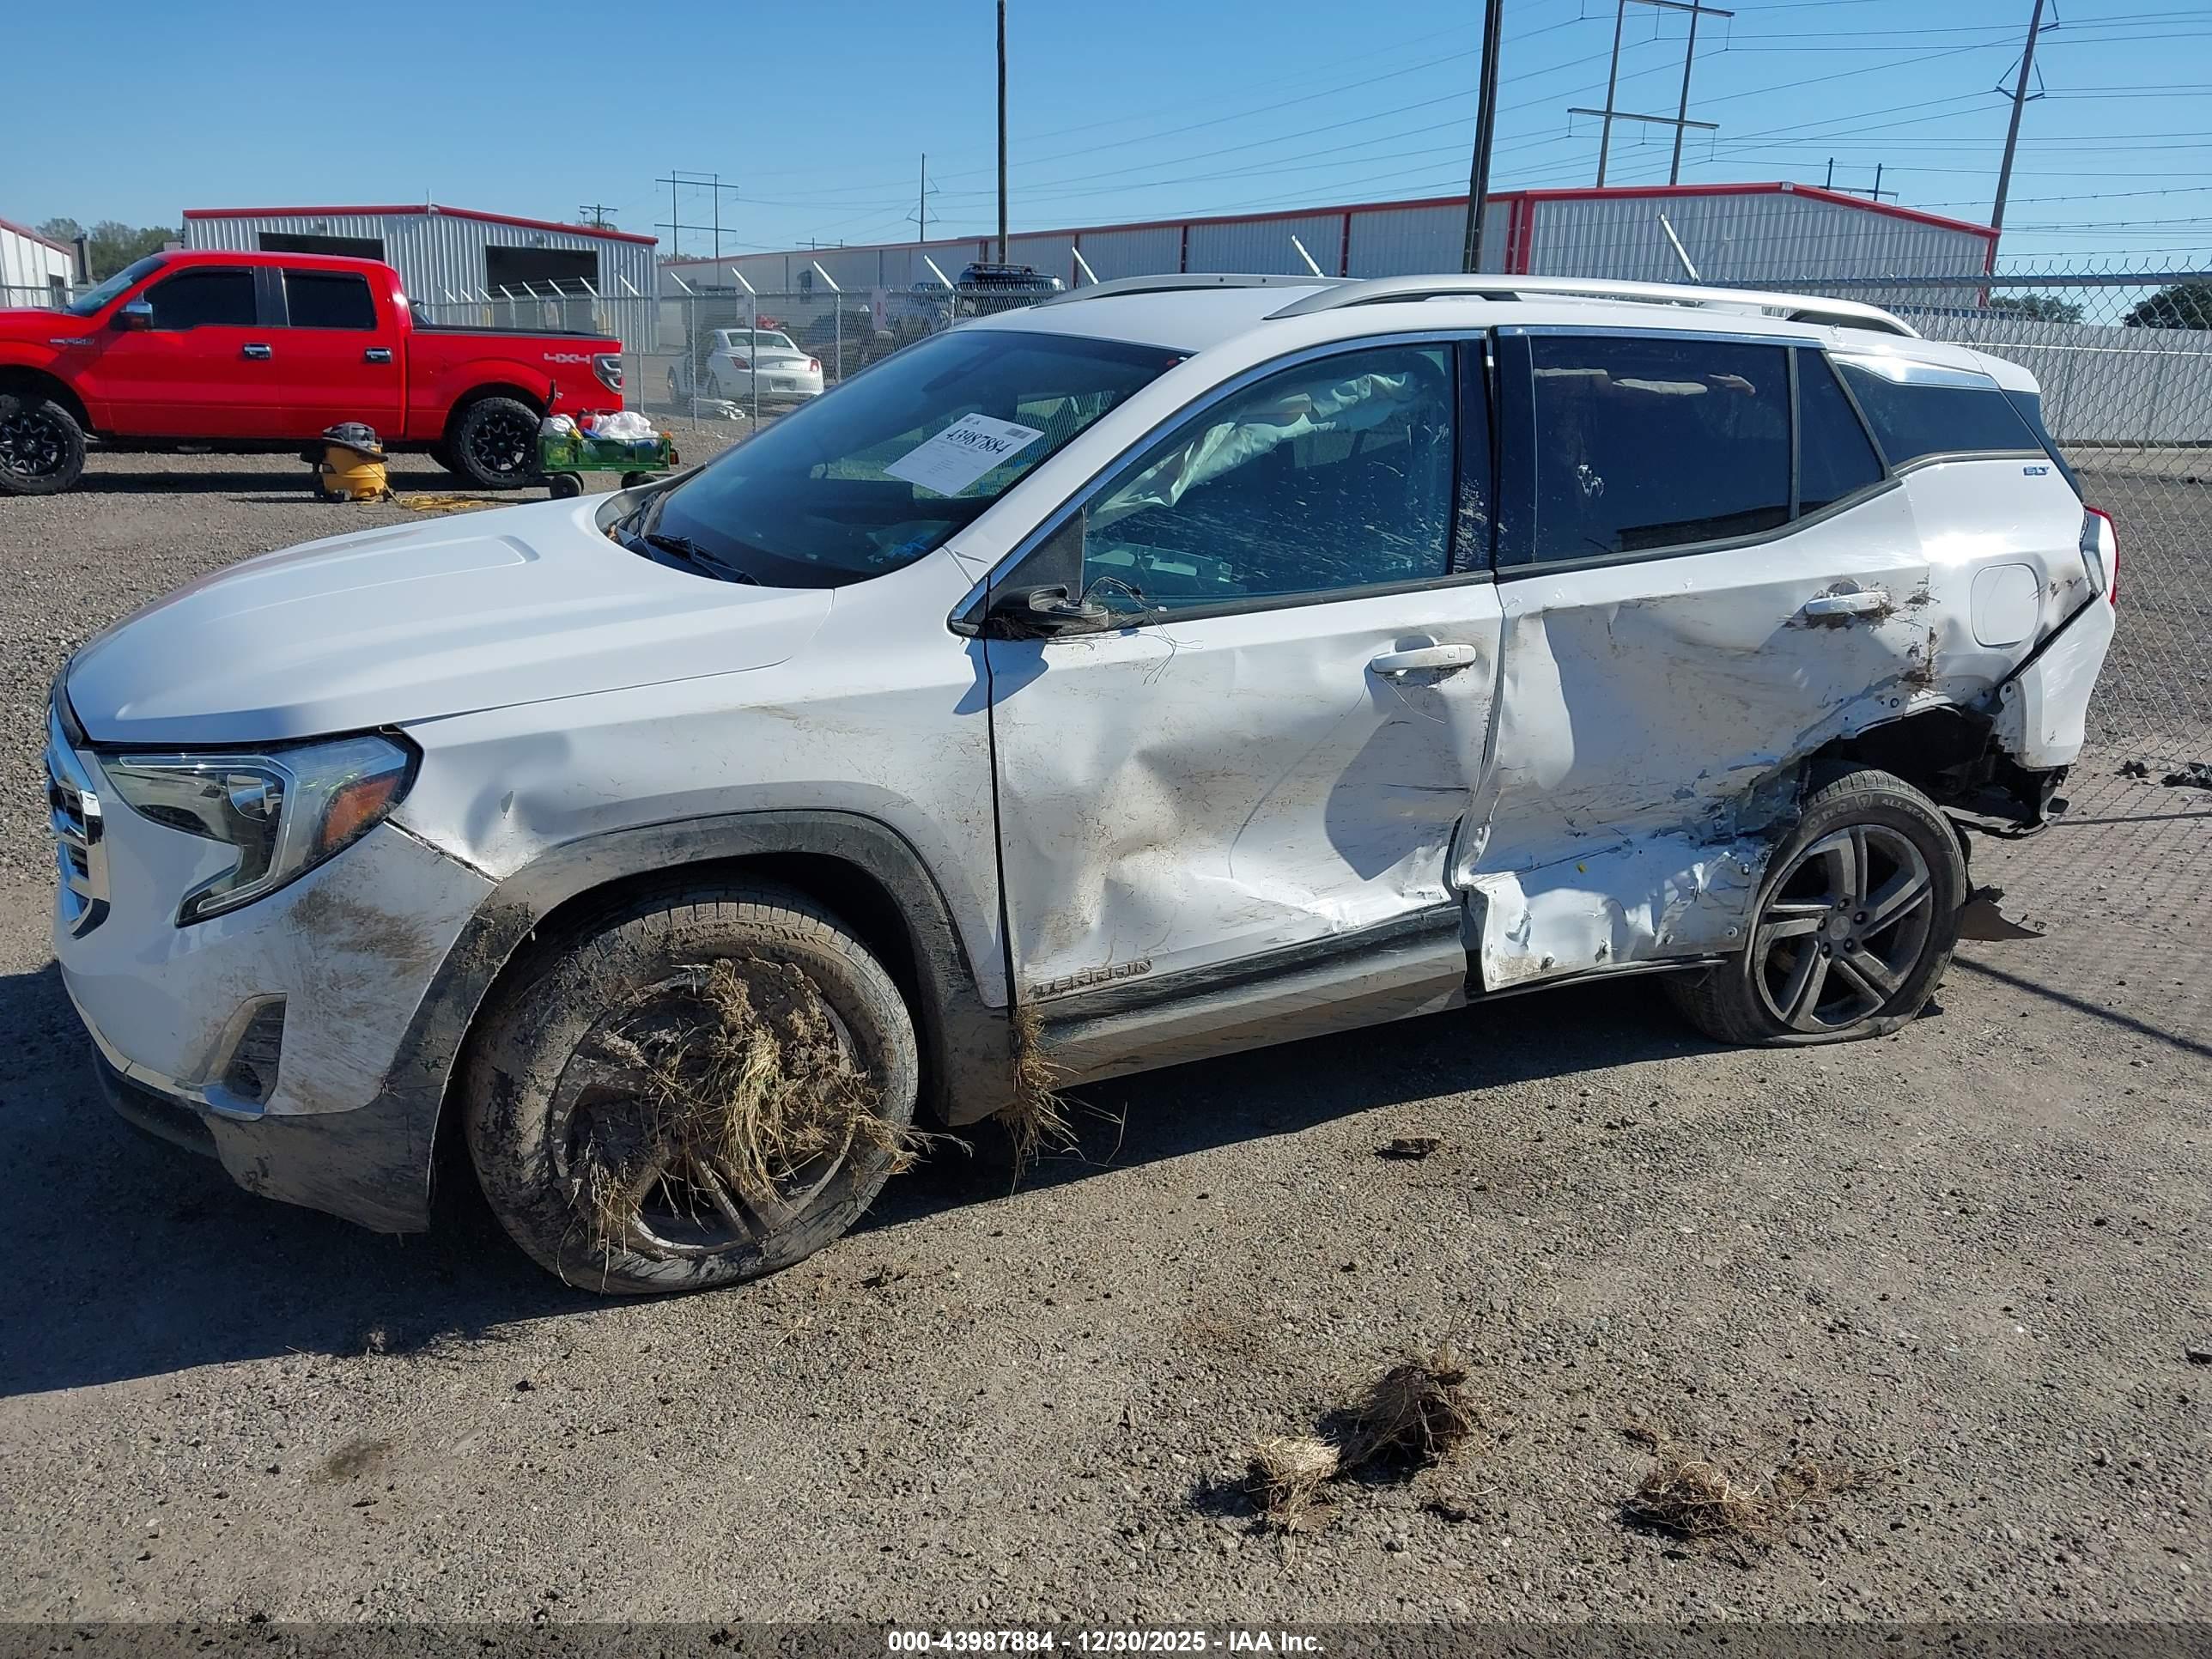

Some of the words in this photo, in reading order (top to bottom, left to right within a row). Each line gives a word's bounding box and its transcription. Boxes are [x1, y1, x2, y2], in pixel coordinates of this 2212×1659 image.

[945, 428, 1012, 455] 43987884
[1881, 798, 1902, 810] ALL
[1904, 805, 1943, 837] SEASON
[1028, 958, 1154, 998] TERRAIN
